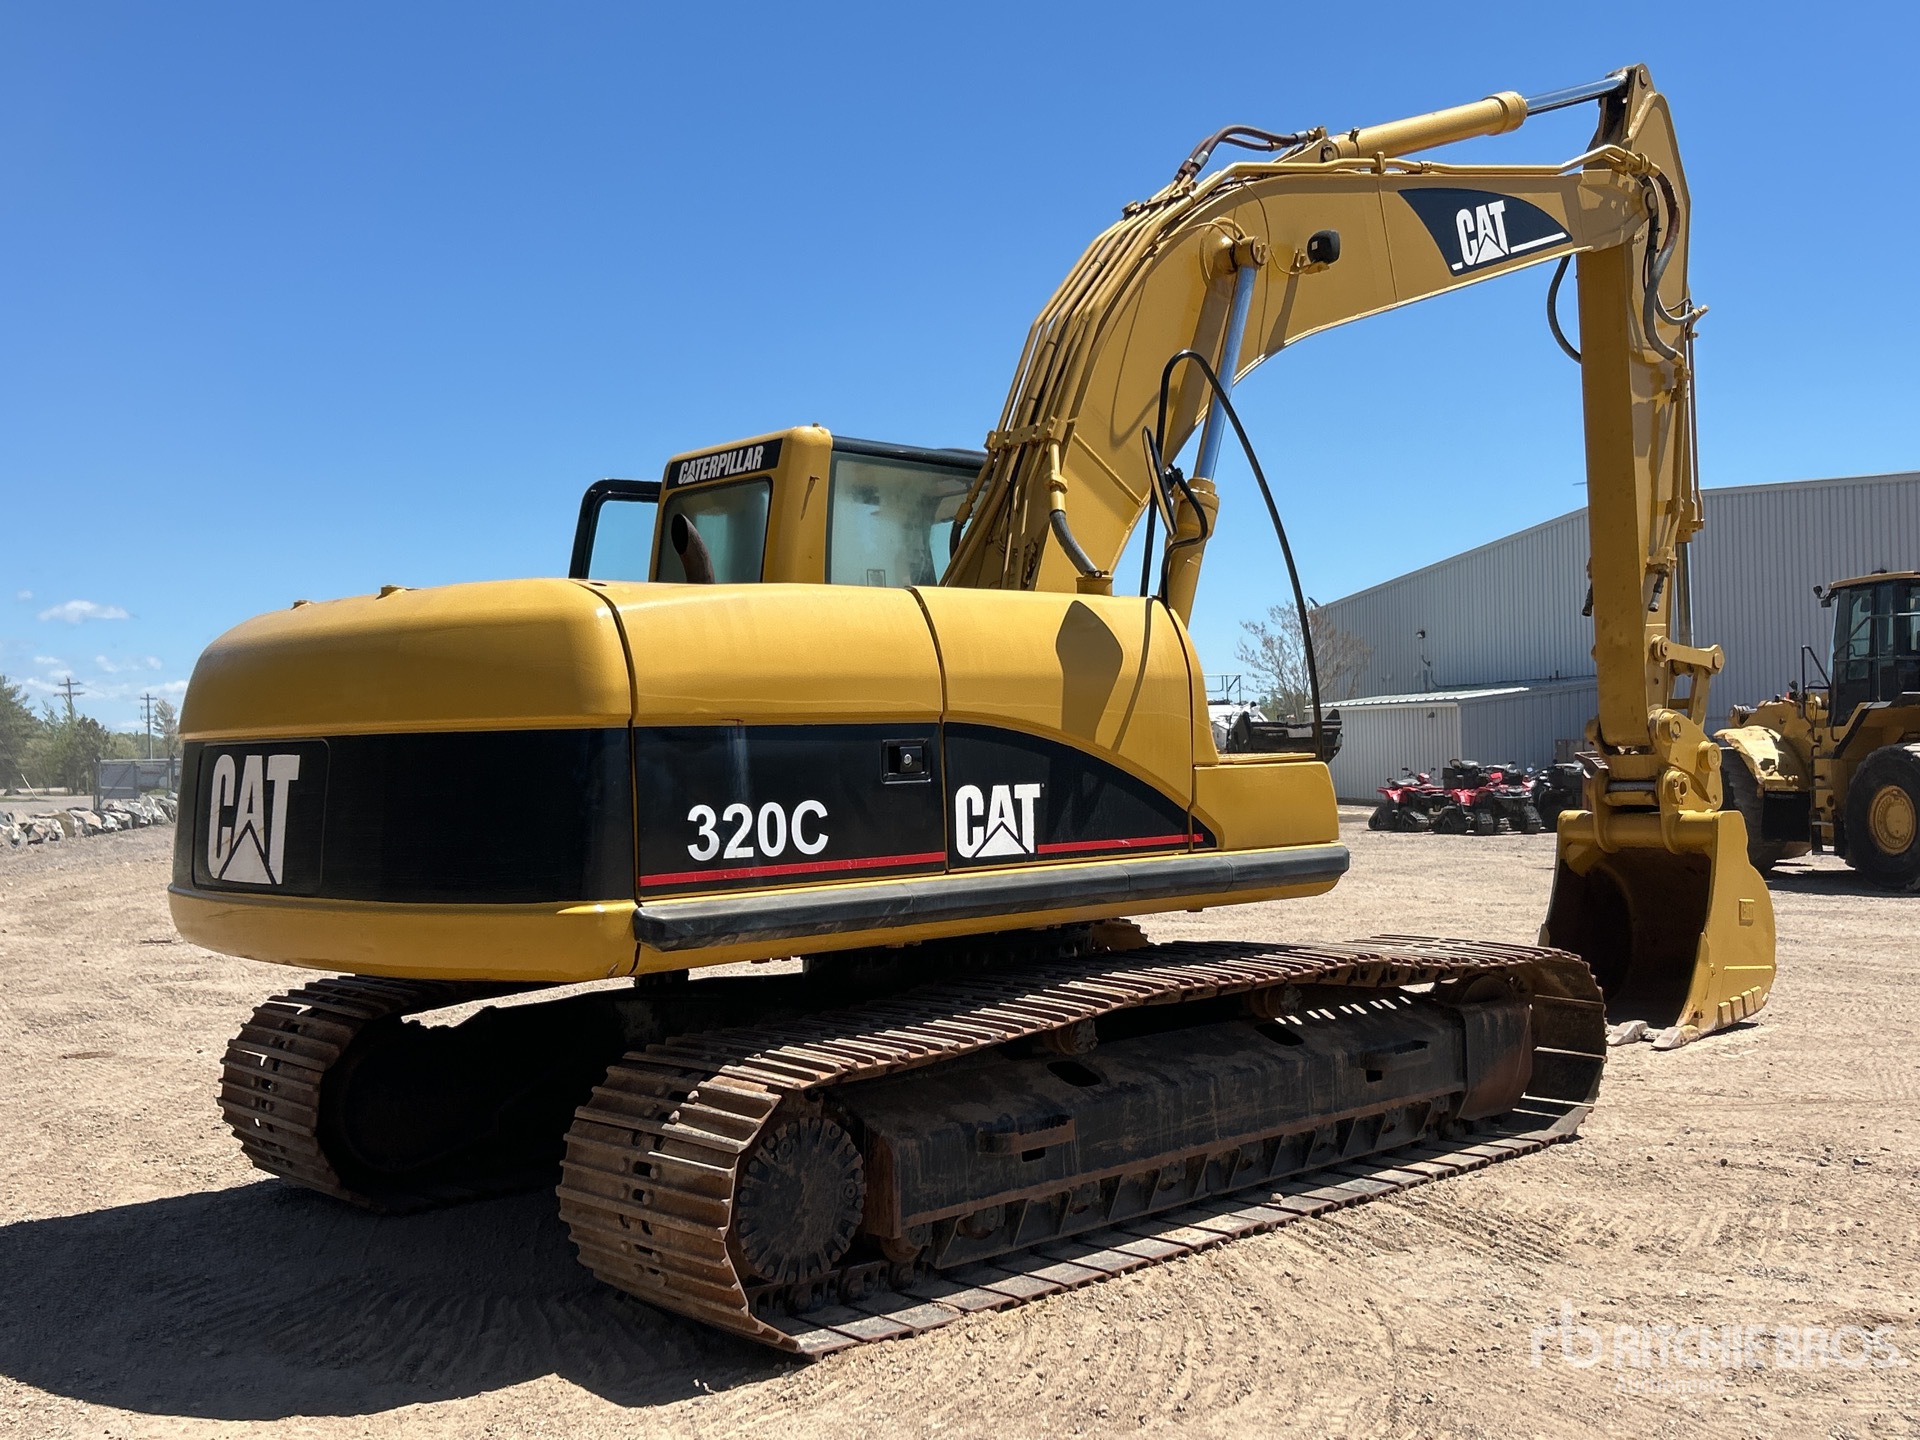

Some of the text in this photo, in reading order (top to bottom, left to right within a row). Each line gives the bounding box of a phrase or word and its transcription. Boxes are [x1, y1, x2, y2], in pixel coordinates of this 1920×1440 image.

[1456, 200, 1509, 265] CAT
[678, 445, 764, 485] CATERPILLAR
[207, 754, 300, 885] CAT
[687, 800, 829, 862] 320C
[955, 783, 1040, 858] CAT
